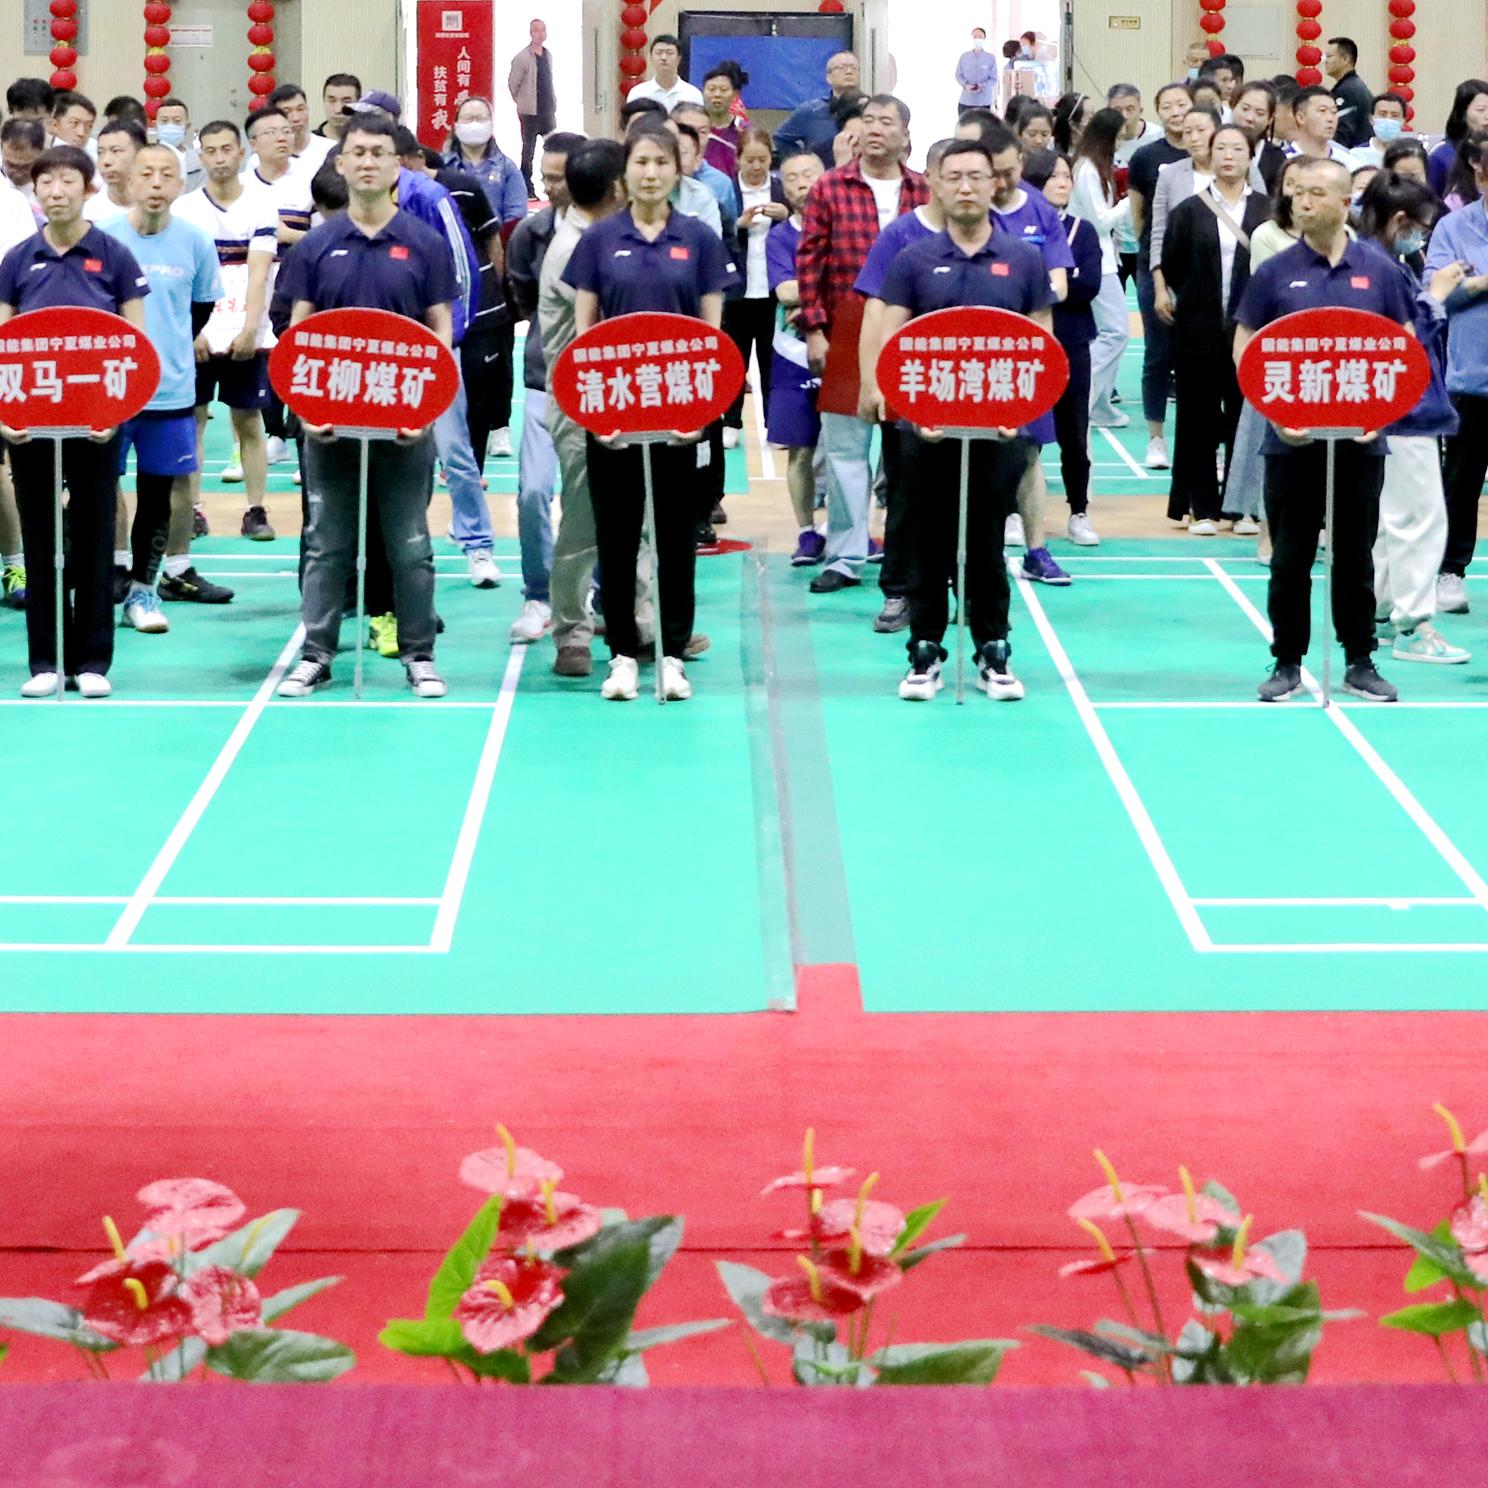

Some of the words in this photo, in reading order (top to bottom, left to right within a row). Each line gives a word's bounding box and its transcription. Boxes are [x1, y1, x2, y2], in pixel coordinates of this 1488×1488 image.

[290, 353, 436, 409] 红柳煤矿
[576, 358, 721, 414] 清水营煤矿
[898, 358, 1045, 403] 羊场湾煤矿
[1262, 358, 1408, 404] 灵新煤矿
